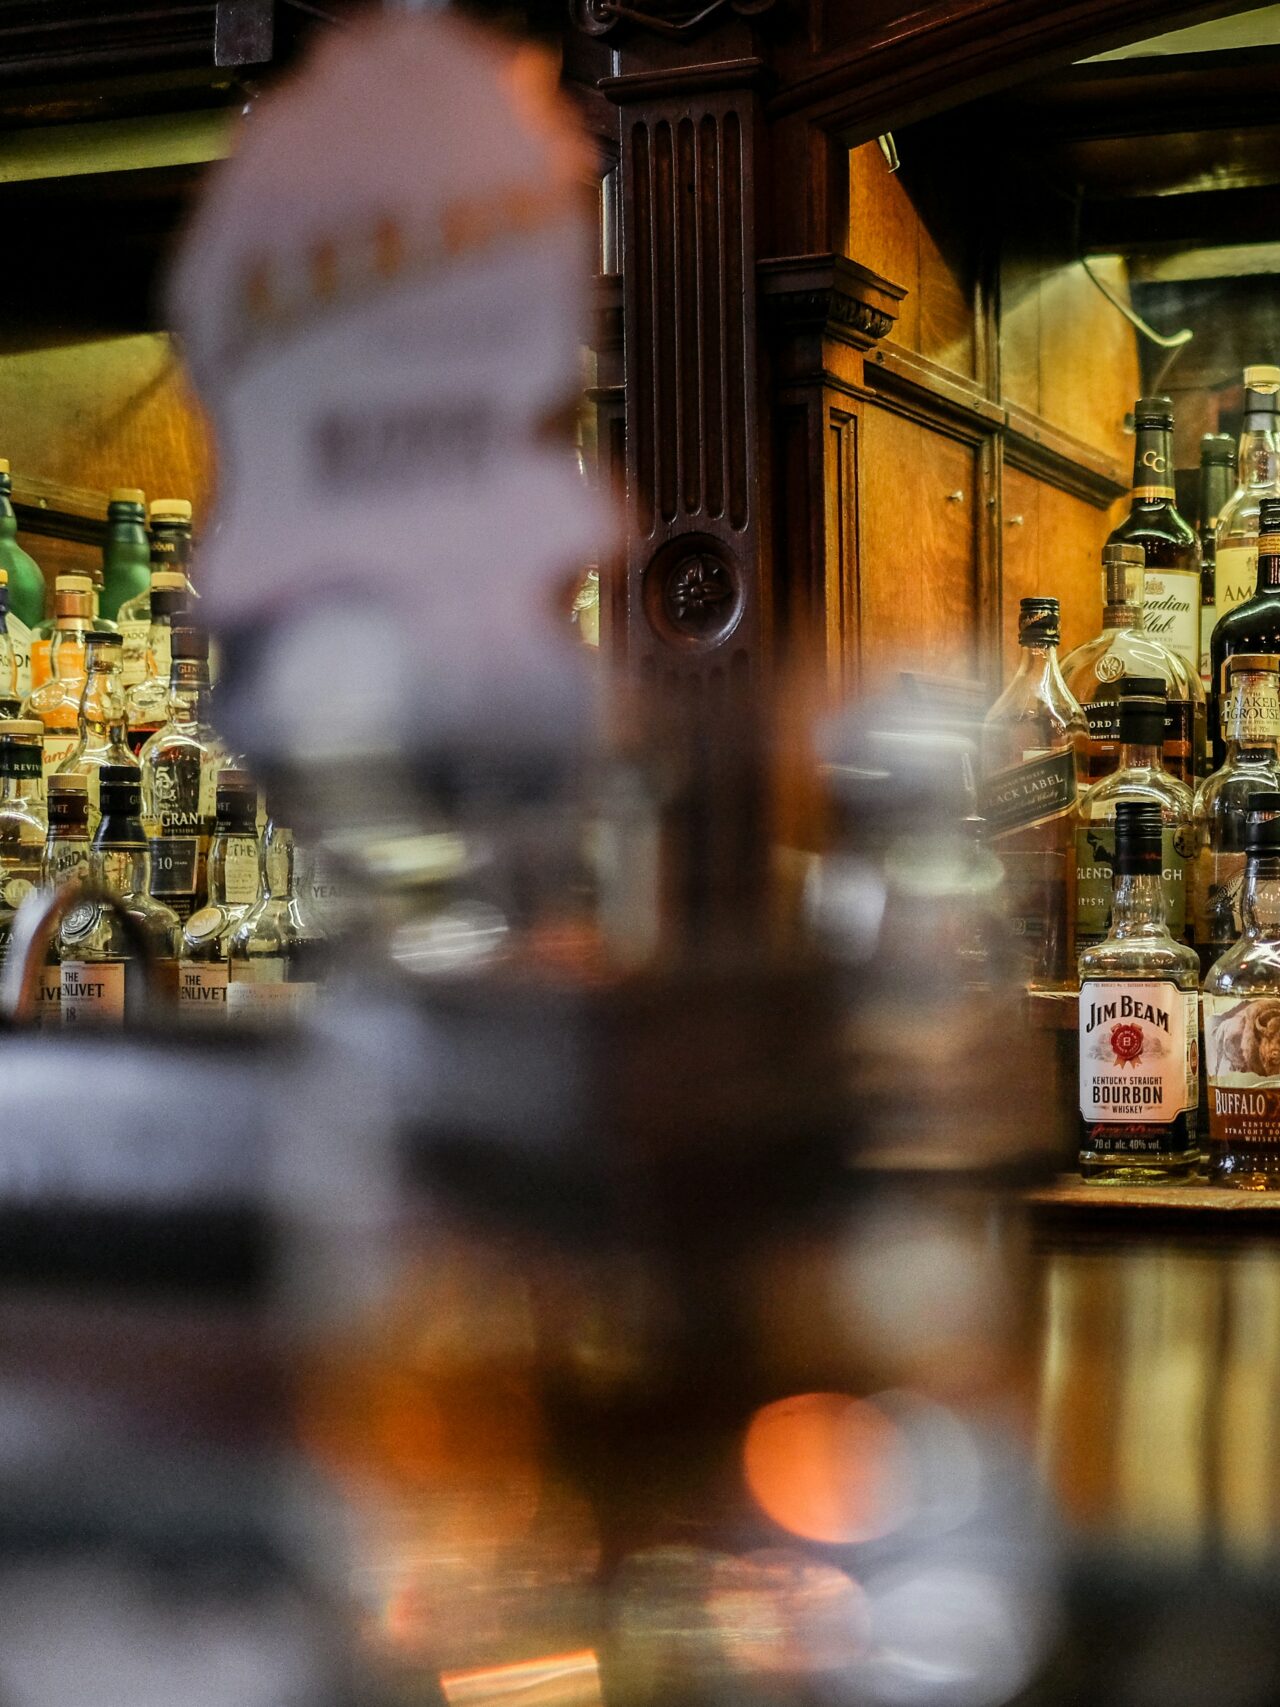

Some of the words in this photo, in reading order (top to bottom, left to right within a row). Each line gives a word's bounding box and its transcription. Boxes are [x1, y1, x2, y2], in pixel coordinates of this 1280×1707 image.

[1233, 697, 1277, 708] NAKED
[1230, 708, 1280, 720] GROUSE
[1023, 773, 1065, 795] LABEL
[161, 810, 205, 827] GRANT
[157, 857, 173, 870] 10
[65, 971, 79, 983] THE
[185, 974, 201, 986] THE
[1086, 1002, 1117, 1033] JIM
[1120, 995, 1169, 1033] BEAM
[1092, 1076, 1127, 1085] KENTUCKY
[1129, 1076, 1163, 1085] STRAIGHT
[1092, 1086, 1163, 1104] BOURBON
[1215, 1088, 1266, 1116] BUFFALO
[1112, 1105, 1143, 1113] WHISKEY
[1224, 1127, 1264, 1135] STRAIGHT
